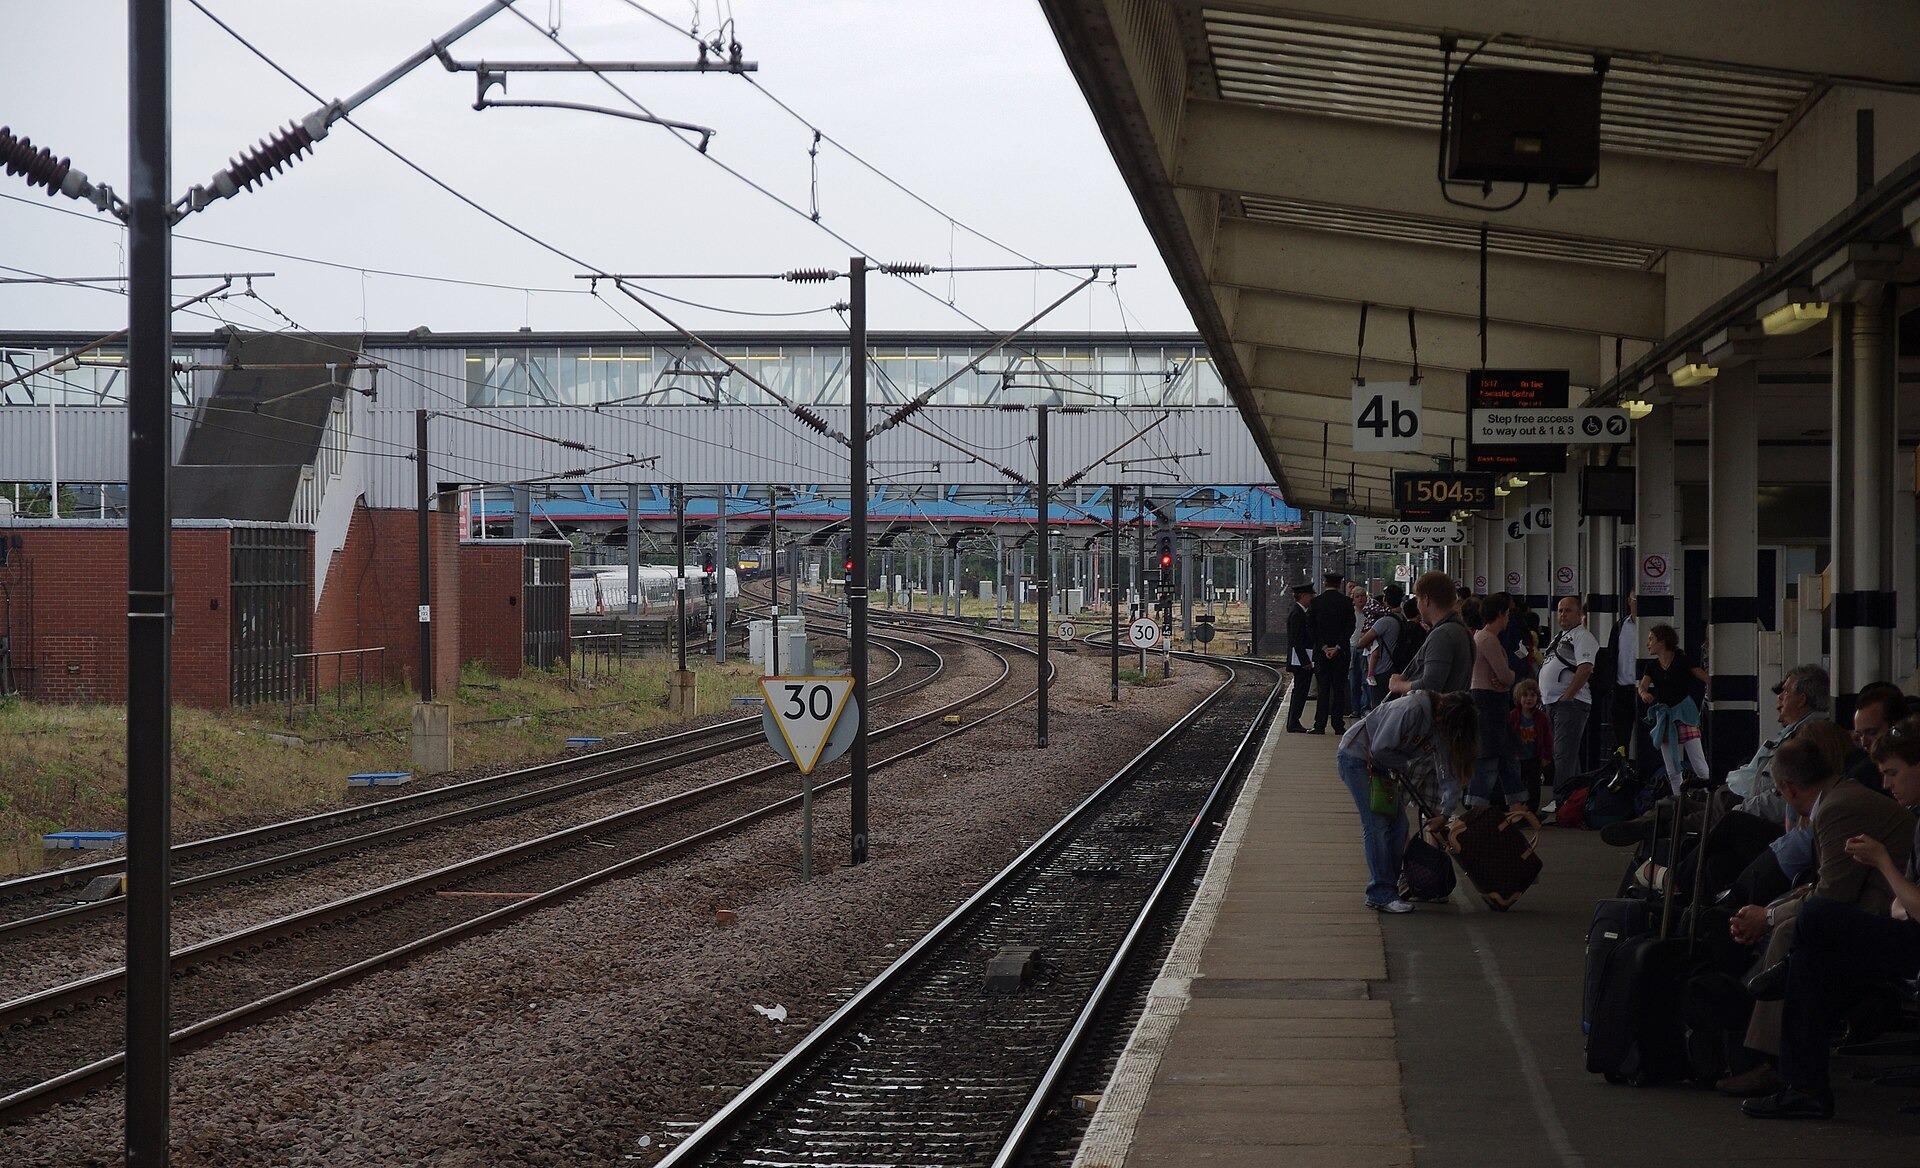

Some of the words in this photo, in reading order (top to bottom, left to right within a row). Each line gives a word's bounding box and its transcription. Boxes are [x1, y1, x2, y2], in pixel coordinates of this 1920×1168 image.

[1357, 394, 1419, 438] 4b
[1488, 413, 1512, 425] Step
[1514, 414, 1535, 423] free
[1482, 427, 1494, 435] to
[1496, 428, 1517, 437] way
[1519, 427, 1536, 435] out
[1538, 426, 1546, 435] &
[1549, 426, 1554, 435] 1
[1557, 426, 1565, 435] &
[1567, 426, 1574, 435] 3
[1414, 525, 1432, 534] Way
[1060, 627, 1073, 637] 30
[1134, 625, 1154, 640] 30
[783, 685, 833, 721] 30
